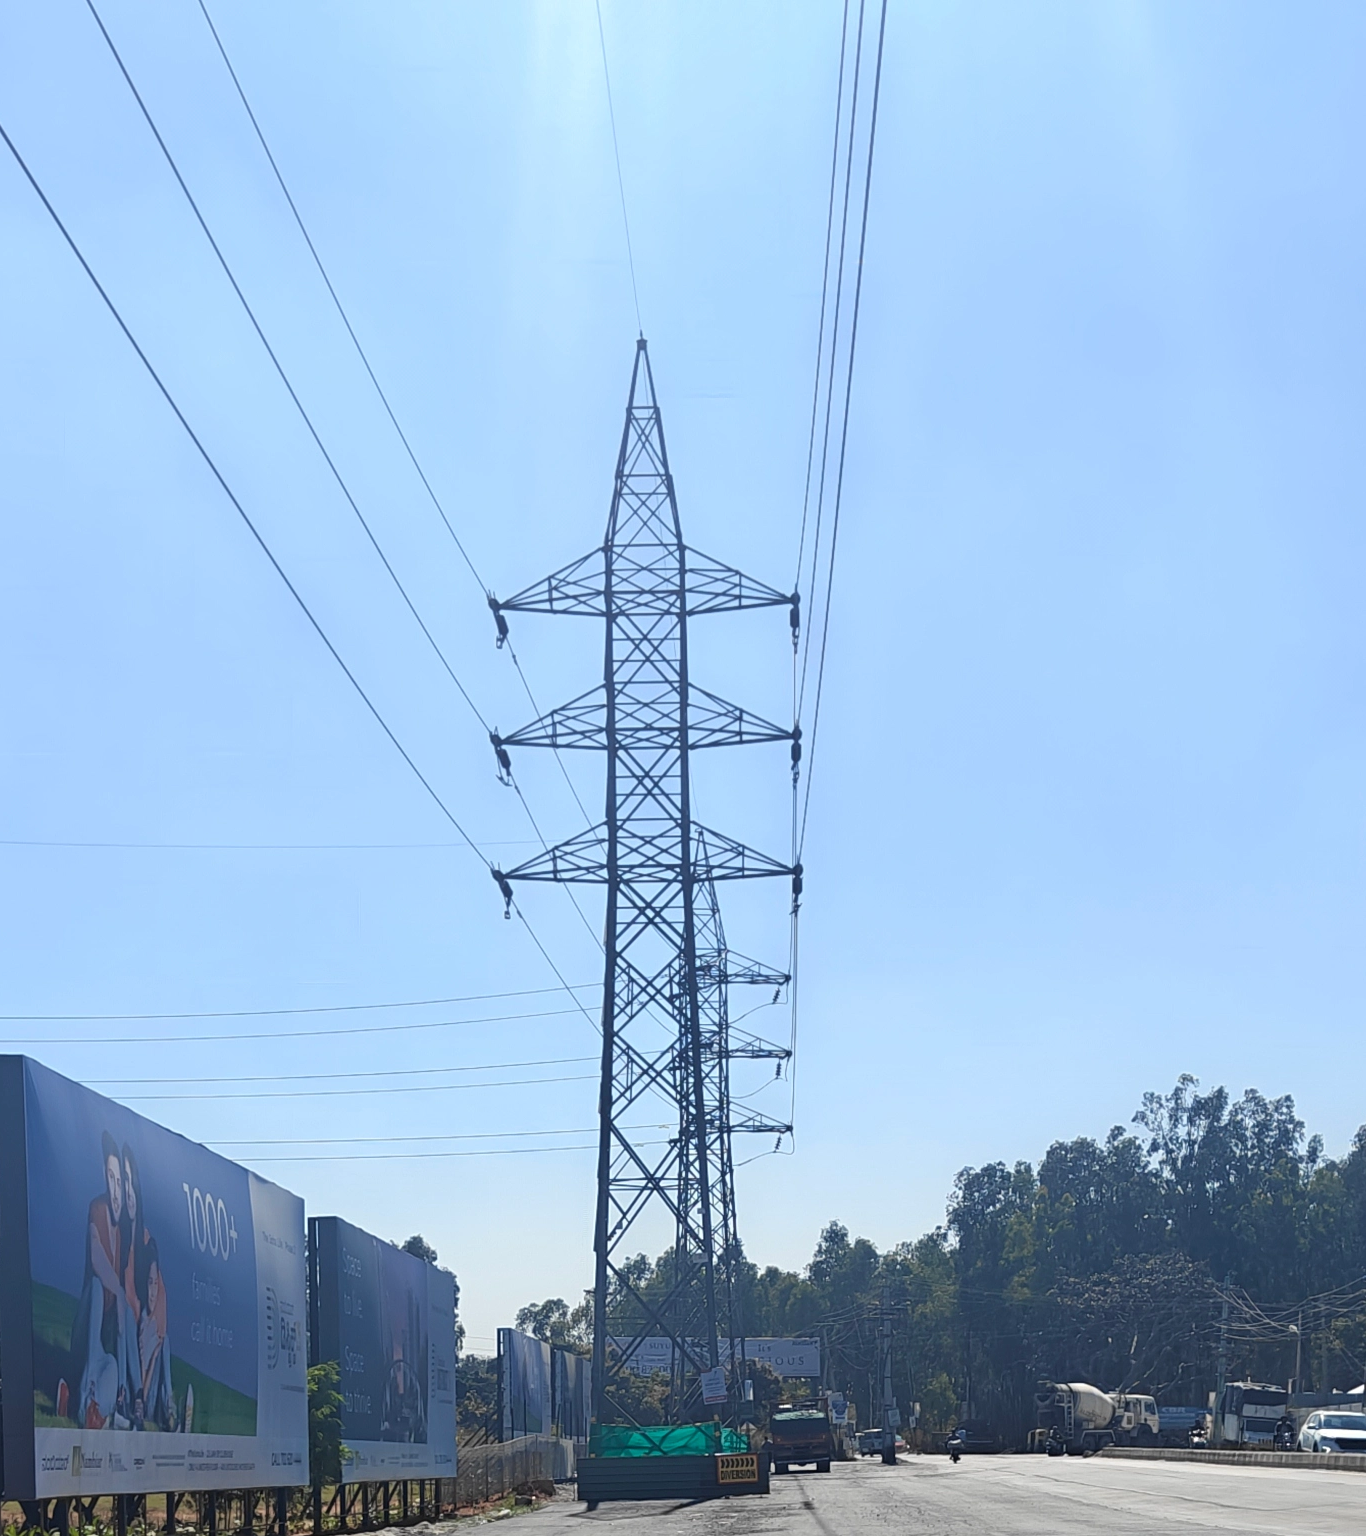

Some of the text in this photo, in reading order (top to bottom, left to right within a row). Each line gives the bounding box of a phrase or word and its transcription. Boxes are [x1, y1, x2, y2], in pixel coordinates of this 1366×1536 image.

[183, 1182, 237, 1261] 1000+
[649, 1342, 673, 1350] SUYU
[720, 1469, 756, 1480] DIVERSION
